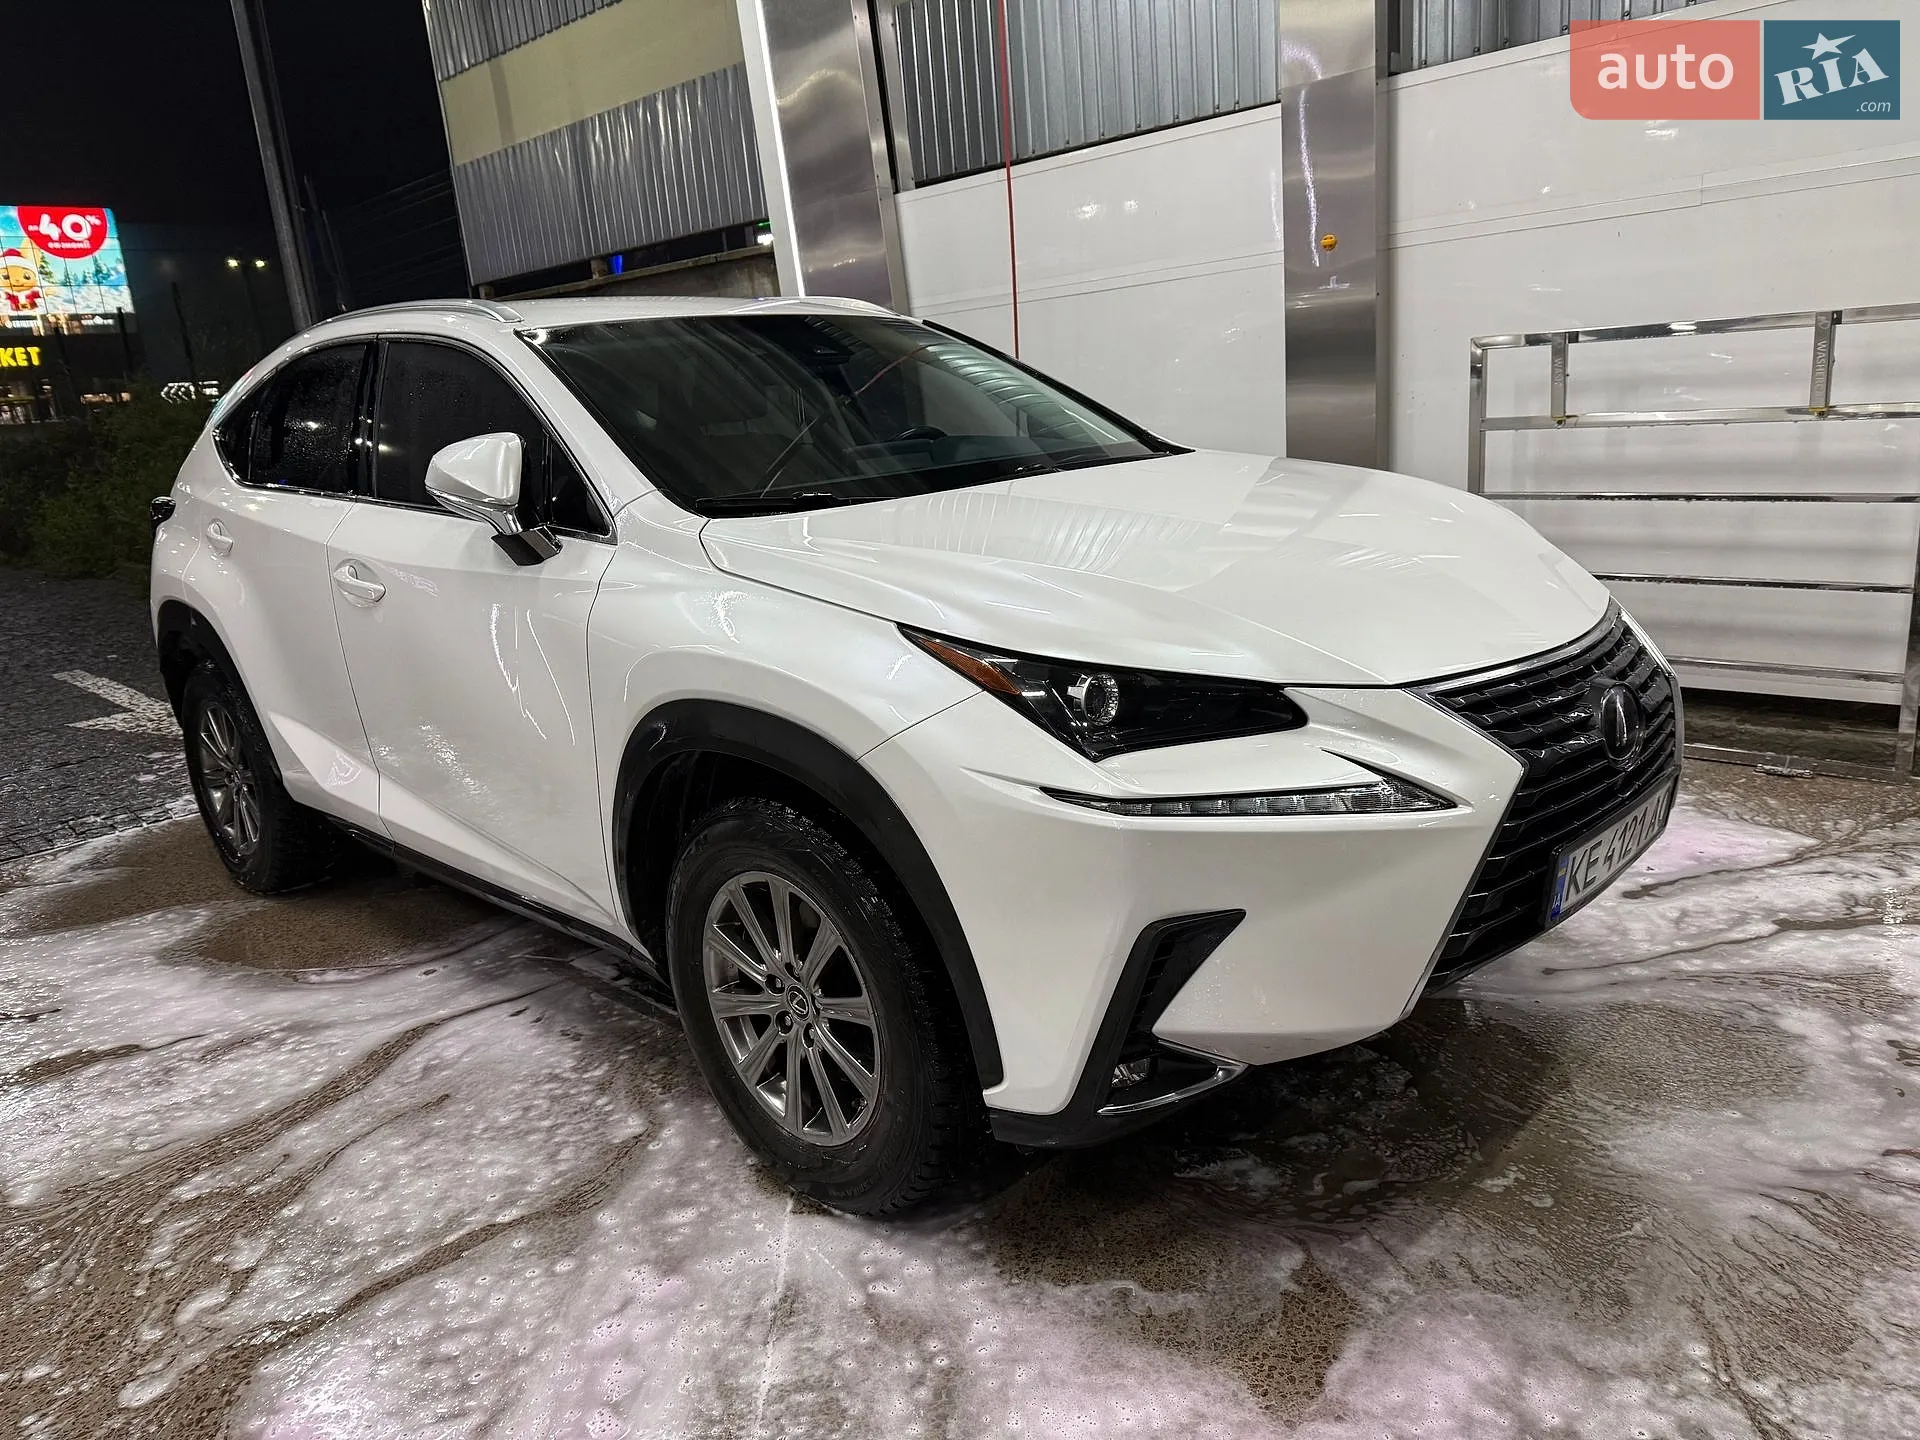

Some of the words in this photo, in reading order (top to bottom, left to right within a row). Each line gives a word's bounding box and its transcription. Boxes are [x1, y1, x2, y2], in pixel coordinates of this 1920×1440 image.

[0, 346, 41, 367] KET
[1565, 839, 1603, 902] KE
[1602, 806, 1648, 872] 4121
